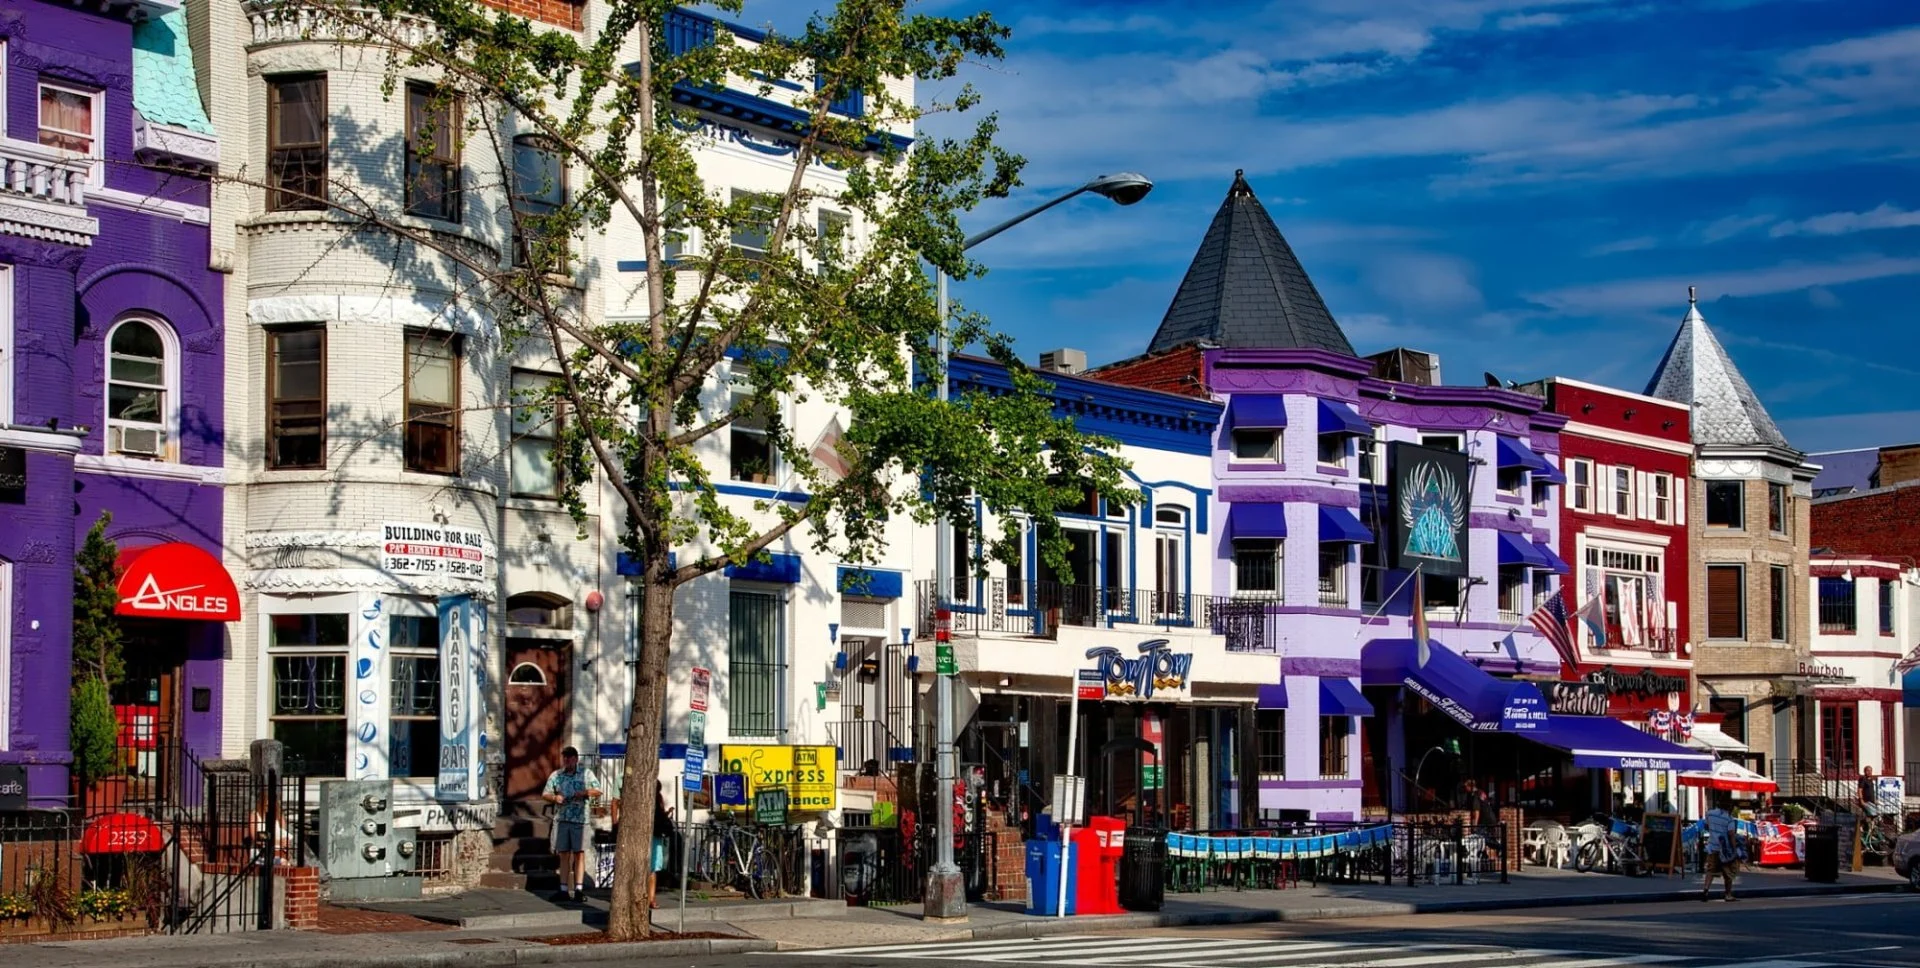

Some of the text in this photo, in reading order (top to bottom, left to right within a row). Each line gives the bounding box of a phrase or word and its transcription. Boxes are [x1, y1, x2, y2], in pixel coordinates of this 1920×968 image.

[385, 526, 482, 547] BUILDING FOR SALE
[389, 543, 406, 553] PAT
[390, 558, 435, 571] 362-7155
[121, 572, 228, 613] ANGLES
[450, 611, 460, 733] PHARMACY
[1592, 665, 1687, 694] The Town Tavern
[1799, 662, 1844, 676] Bourbon
[1404, 677, 1422, 691] GREEN
[1478, 722, 1499, 730] HELL
[1551, 683, 1606, 715] Station
[440, 745, 468, 769] BAR
[796, 752, 815, 762] ATM
[1621, 757, 1671, 769] Columbia Station
[749, 749, 825, 789] Express
[757, 792, 785, 811] ATM
[964, 791, 973, 832] zero
[427, 808, 488, 825] PHARMACY
[108, 830, 147, 845] 2339
